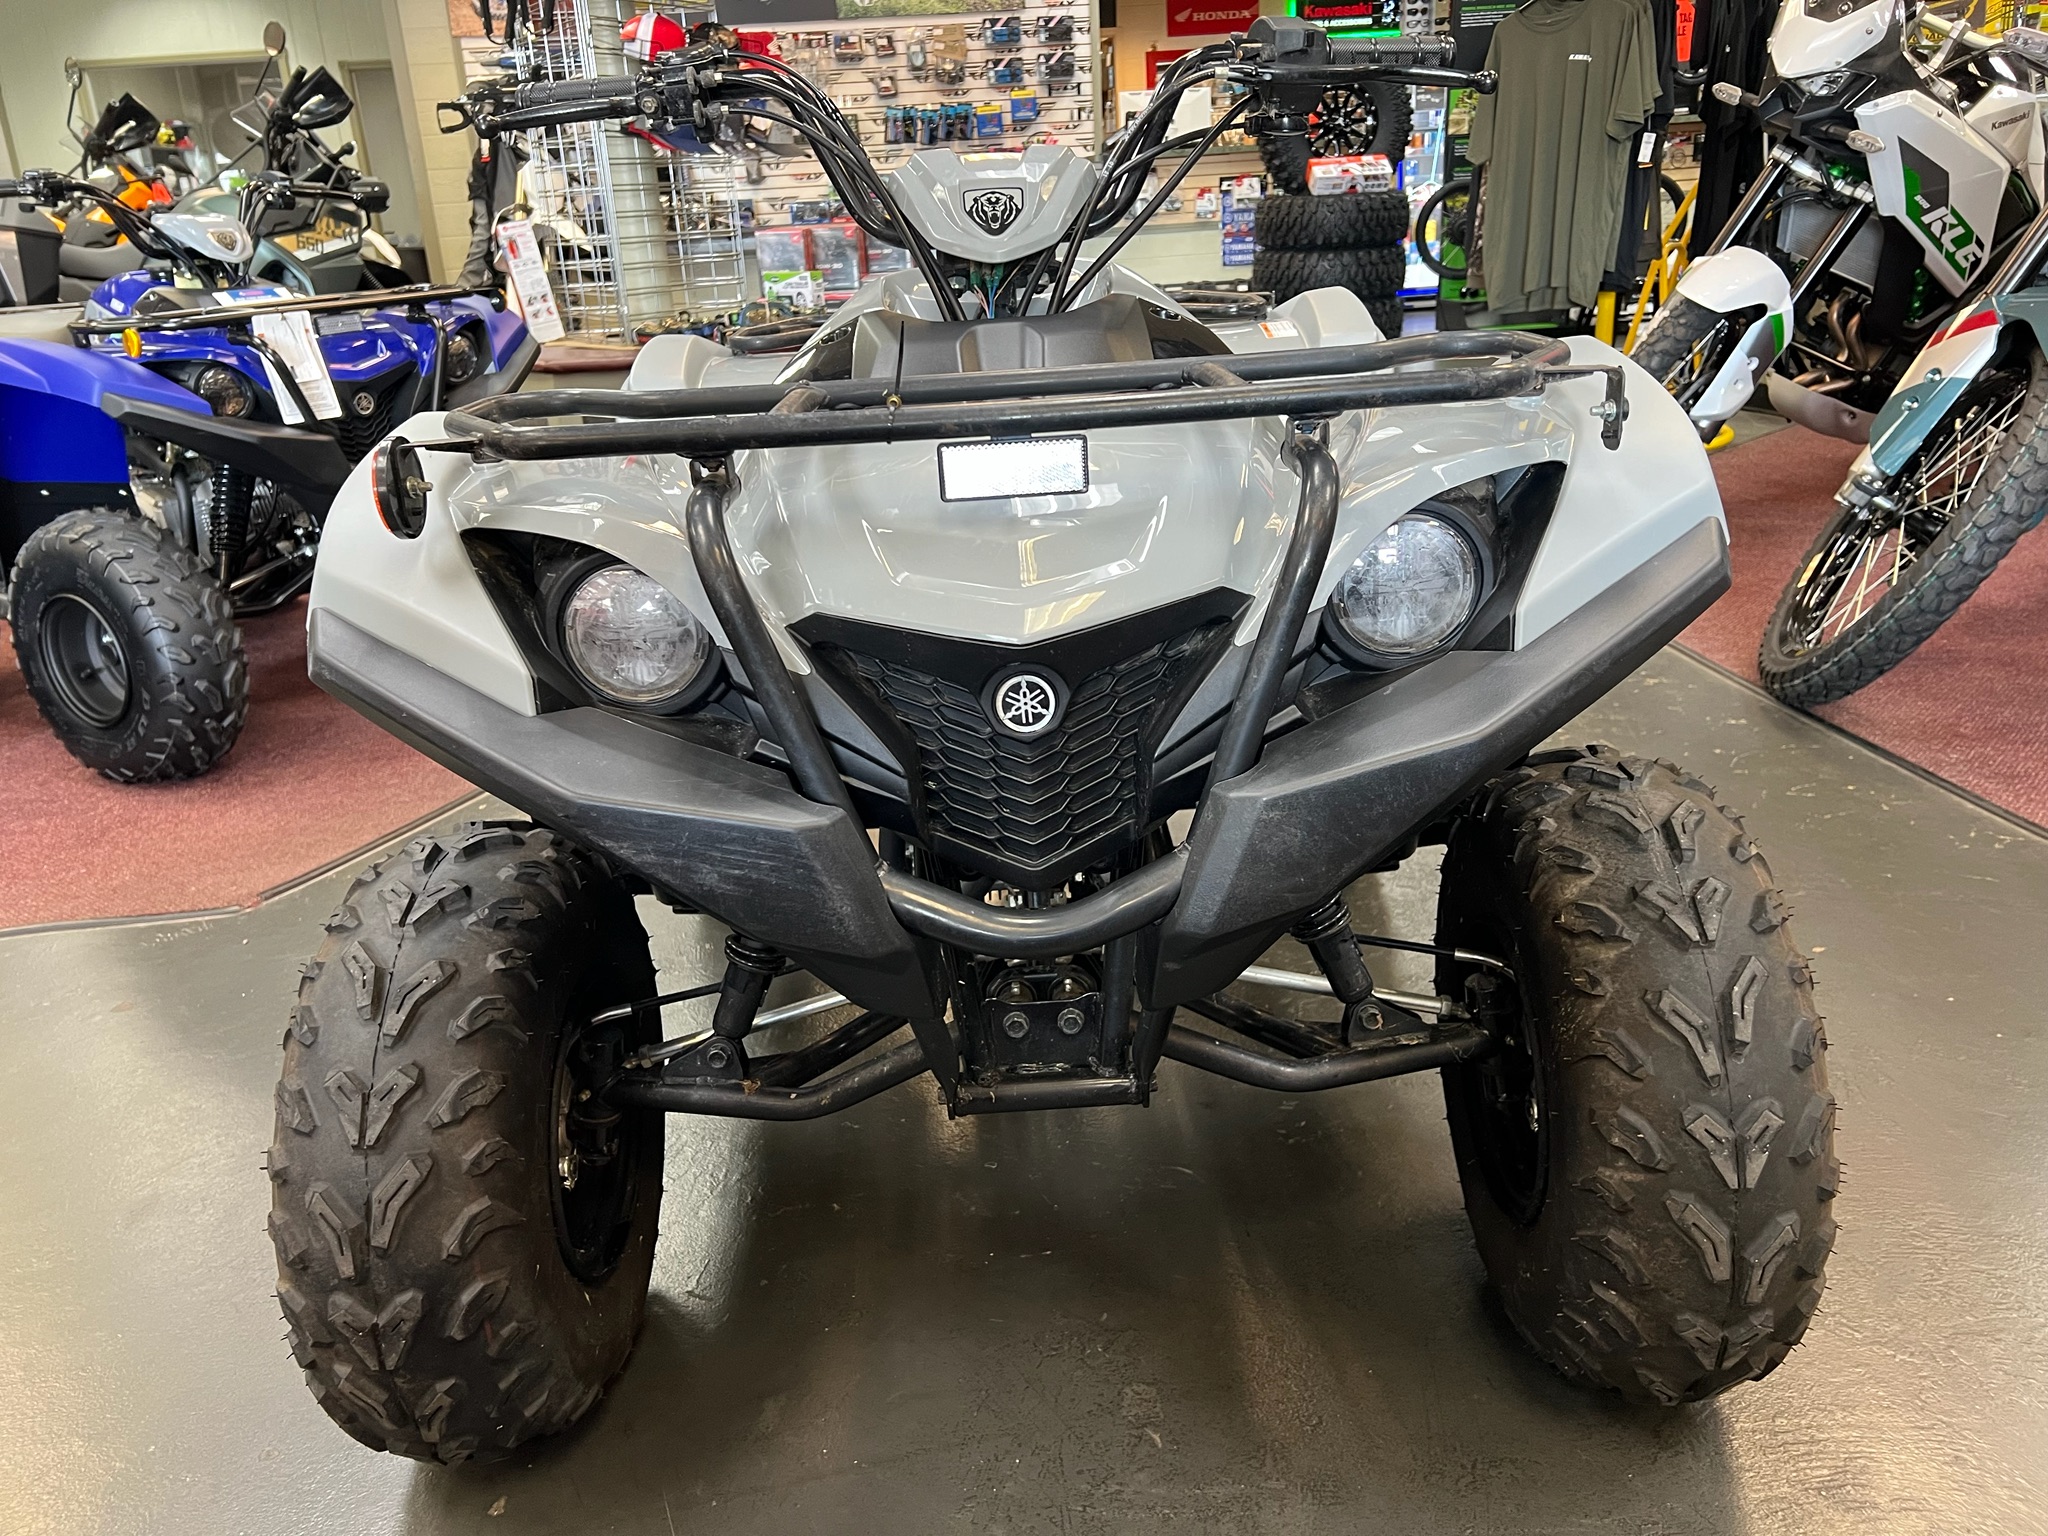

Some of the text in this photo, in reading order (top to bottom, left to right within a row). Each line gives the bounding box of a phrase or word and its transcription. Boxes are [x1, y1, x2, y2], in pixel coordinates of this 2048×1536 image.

[1192, 10, 1252, 21] HONDA
[1304, 2, 1373, 18] Kawasaki
[1991, 110, 2030, 131] Kawasaki
